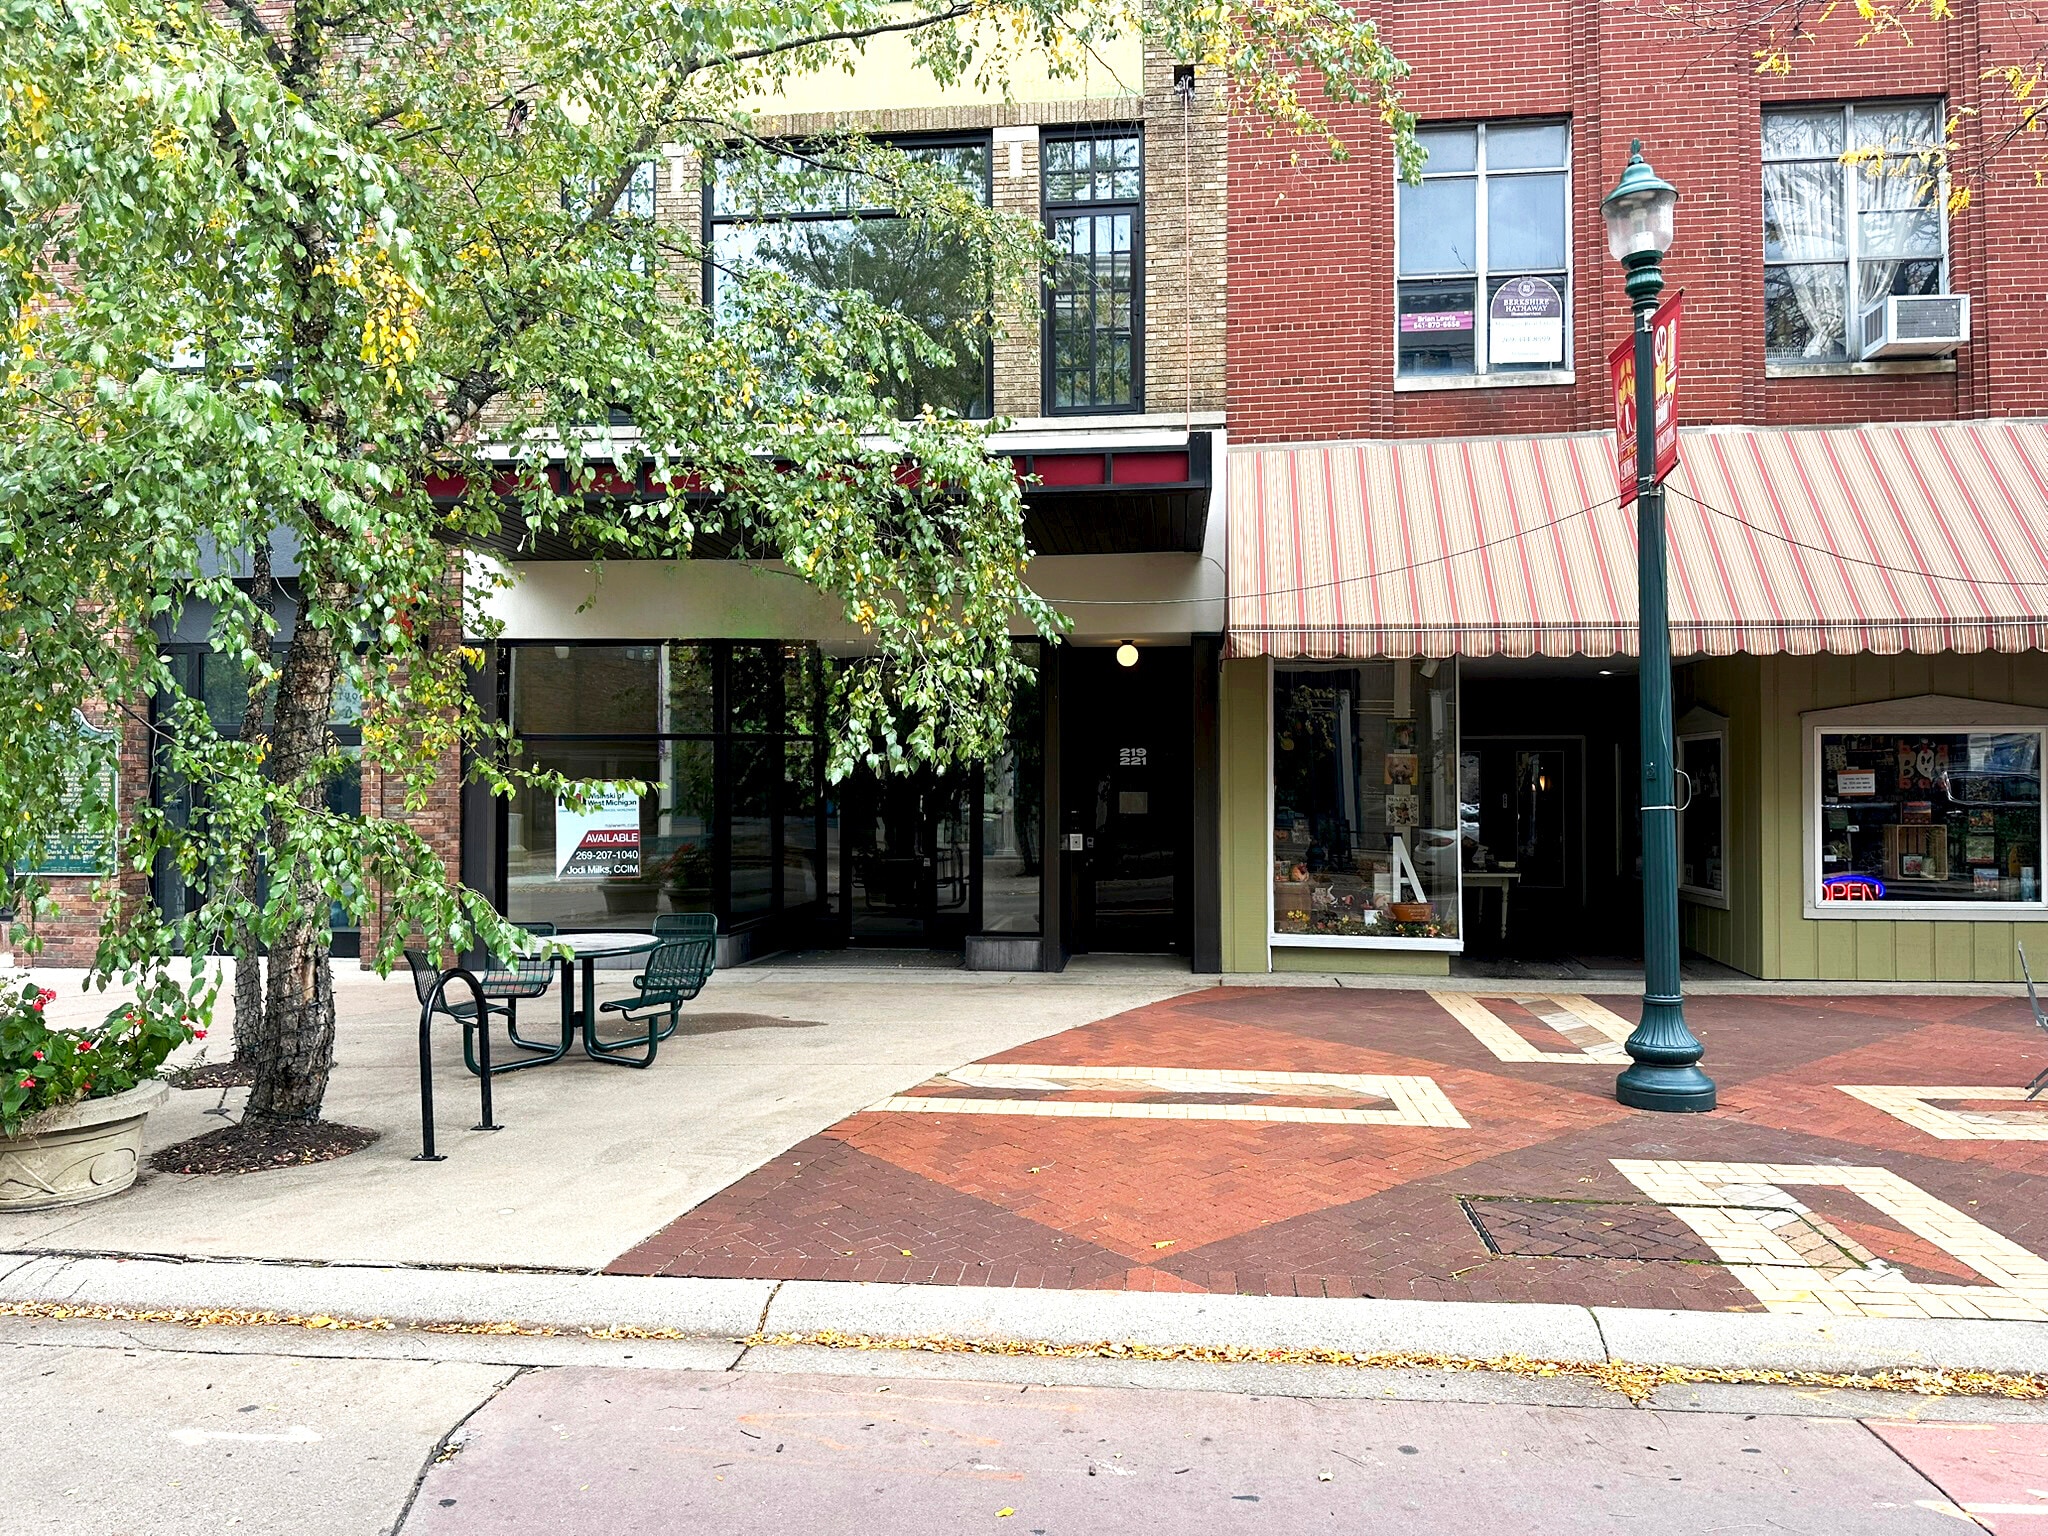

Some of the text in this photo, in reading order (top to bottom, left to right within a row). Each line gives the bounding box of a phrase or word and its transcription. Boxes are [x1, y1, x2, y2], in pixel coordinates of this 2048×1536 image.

[1503, 298, 1550, 306] BERKSHIRE
[1119, 747, 1147, 757] 219
[1119, 756, 1147, 766] 221
[605, 799, 637, 807] Michigan
[585, 833, 639, 843] AVAILABLE
[576, 849, 639, 860] 269-207-1040
[566, 864, 639, 875] Jodi Milks, CCIM
